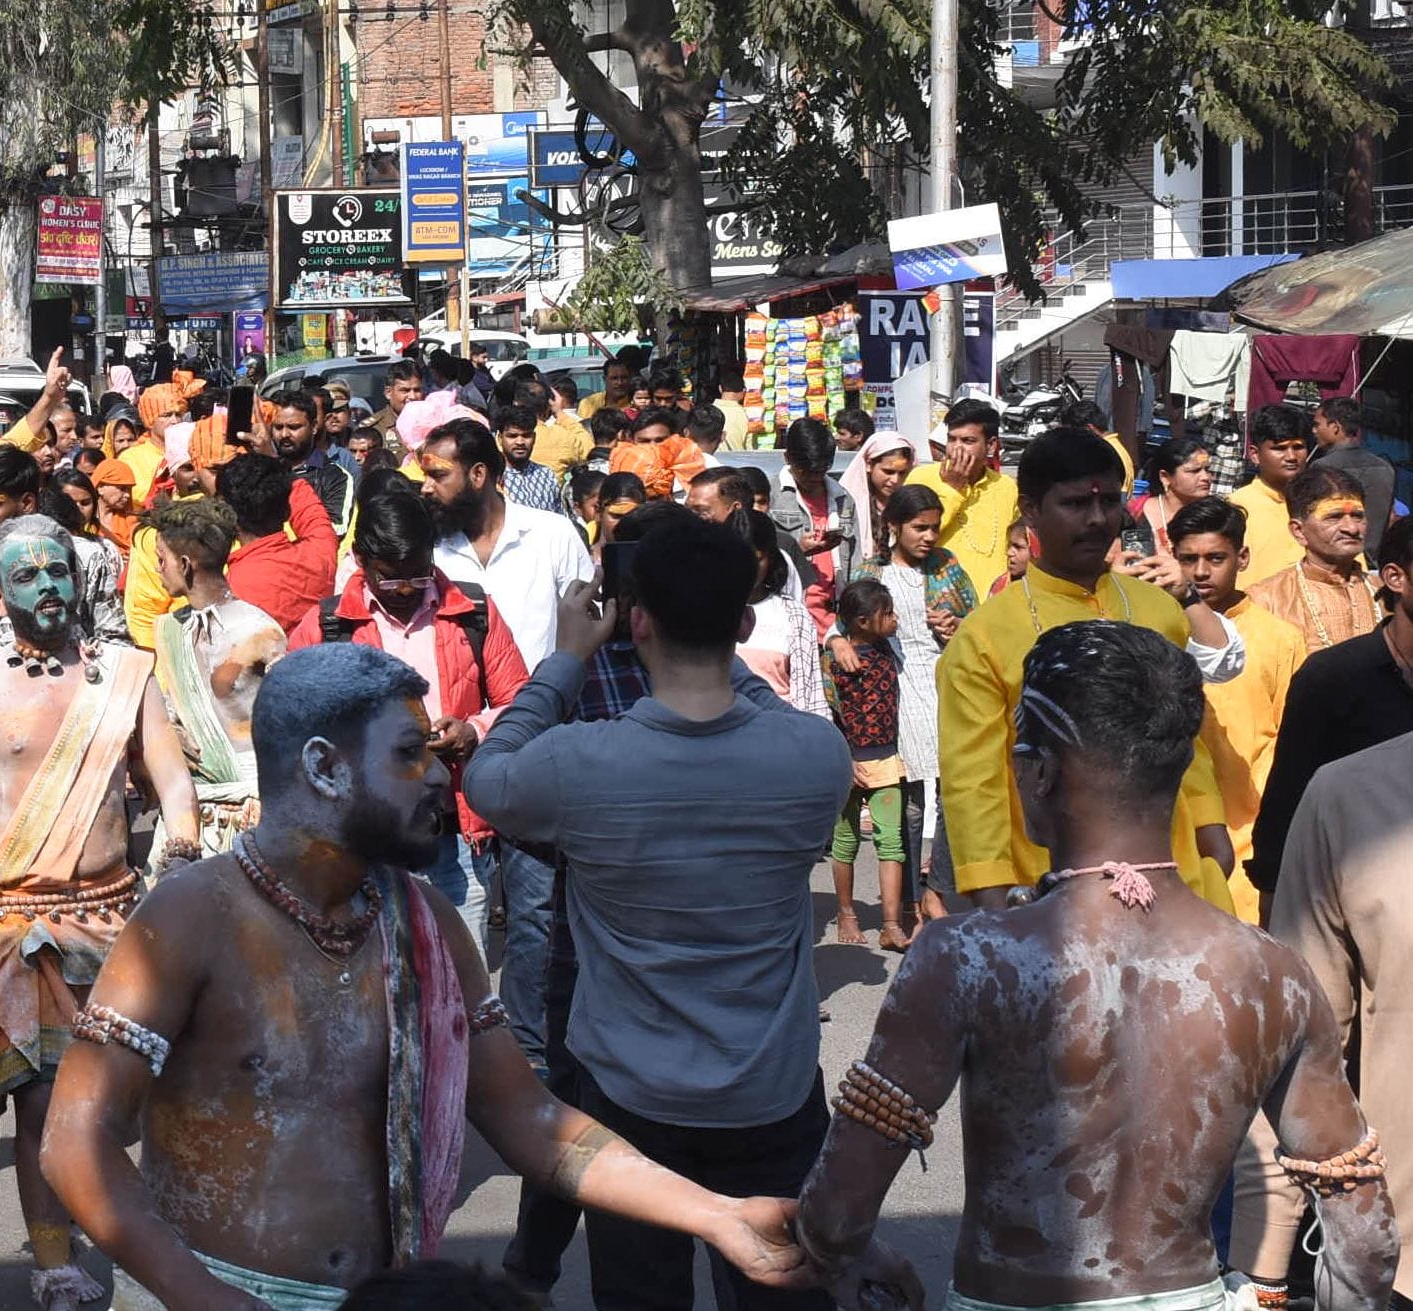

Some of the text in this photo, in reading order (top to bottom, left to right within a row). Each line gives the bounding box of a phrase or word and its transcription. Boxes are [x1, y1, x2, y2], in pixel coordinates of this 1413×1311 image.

[410, 147, 459, 156] FEDERAL BANK
[547, 150, 608, 166] VOLS
[374, 199, 401, 213] 24/
[302, 229, 392, 243] STOREEX
[308, 245, 385, 255] GROCERY BAKERY
[713, 243, 758, 260] Mens
[870, 299, 980, 336] RAE
